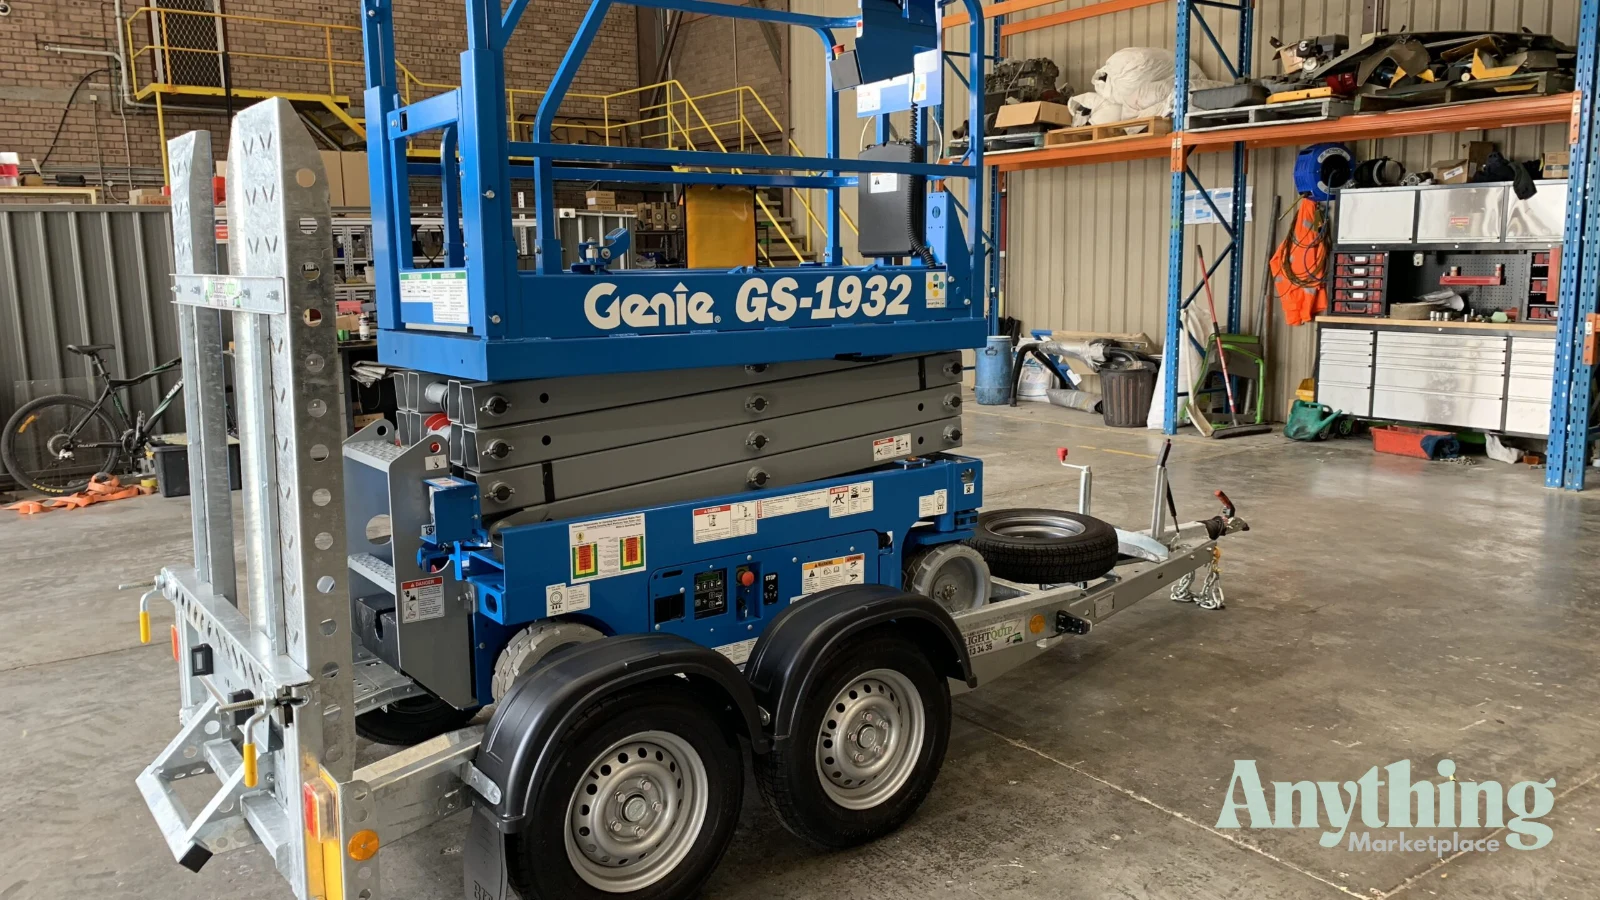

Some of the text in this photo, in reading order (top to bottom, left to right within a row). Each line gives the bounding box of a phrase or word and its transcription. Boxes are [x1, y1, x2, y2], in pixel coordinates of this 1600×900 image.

[584, 274, 912, 330] Genie GS-1932
[765, 574, 777, 582] STOP
[415, 579, 435, 587] DANGER
